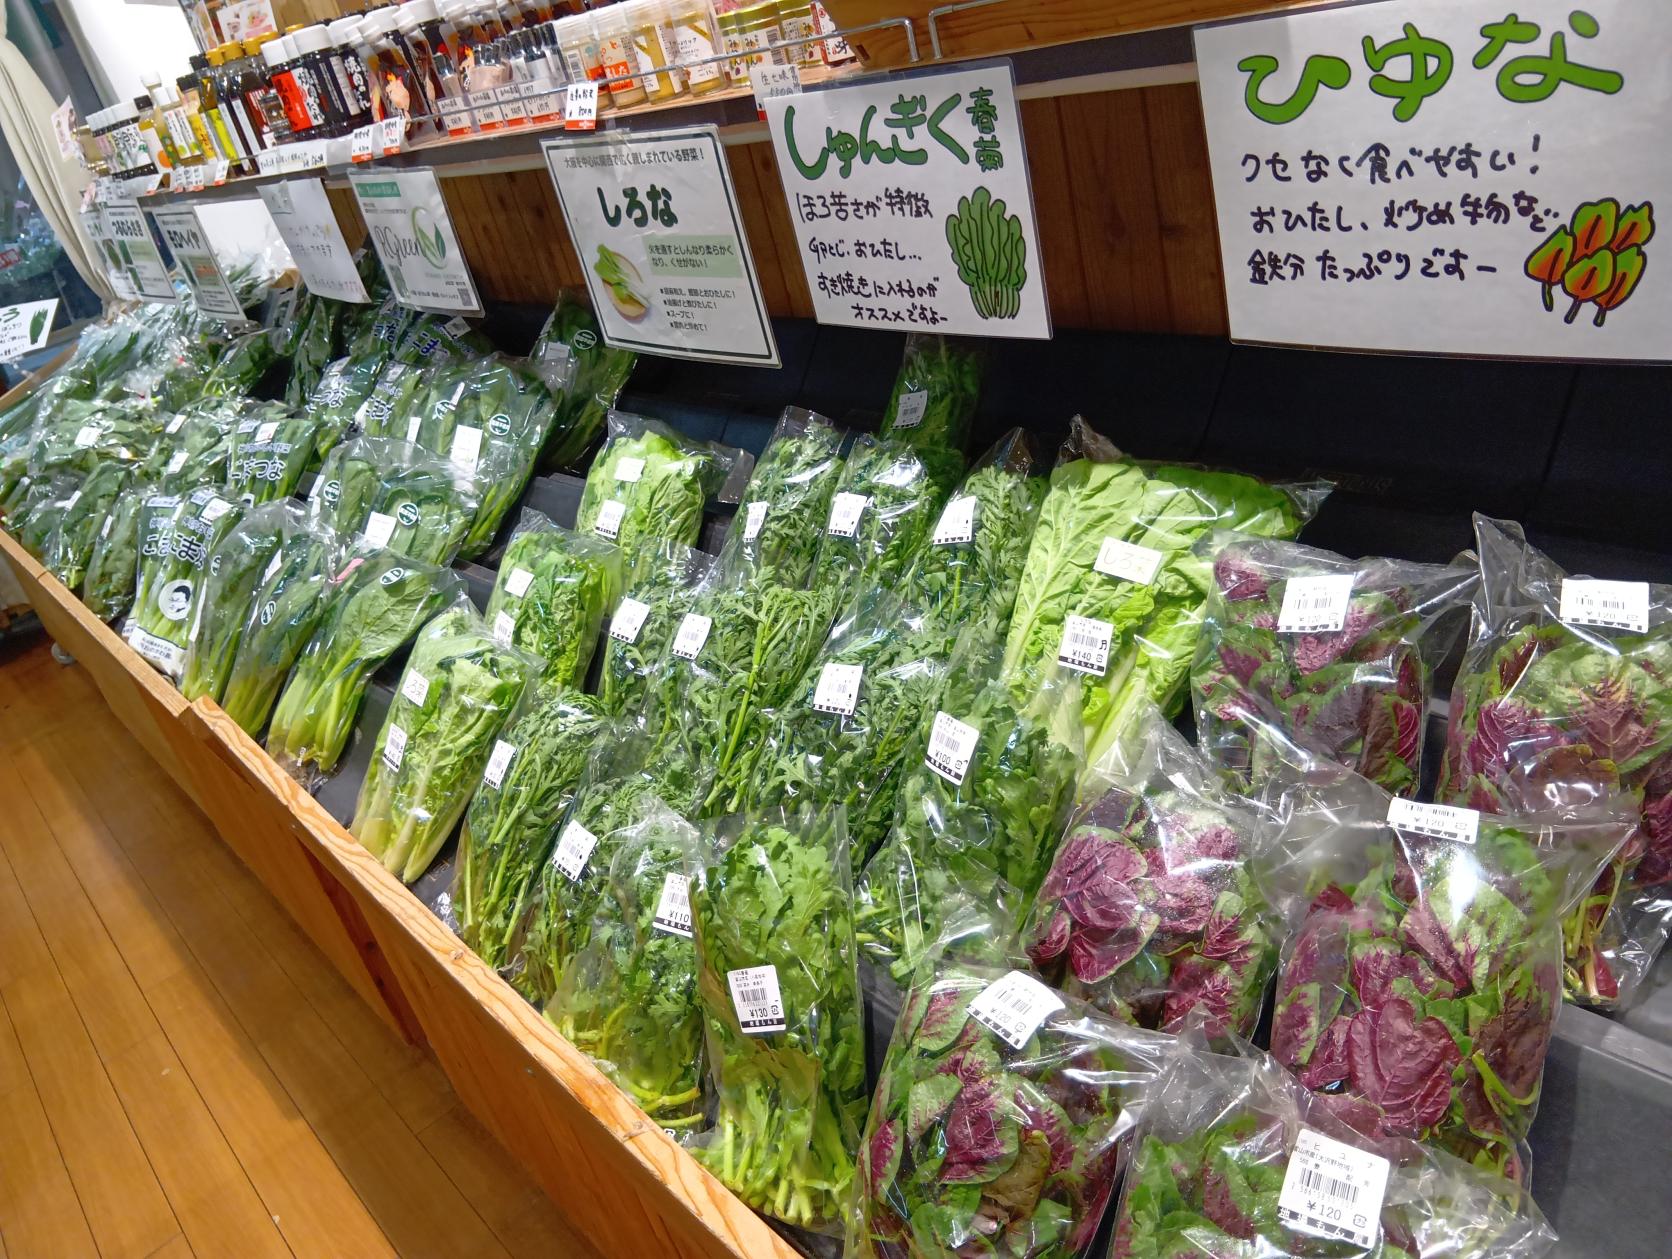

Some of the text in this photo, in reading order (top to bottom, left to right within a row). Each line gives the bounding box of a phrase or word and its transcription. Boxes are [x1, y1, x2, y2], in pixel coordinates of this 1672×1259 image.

[1238, 11, 1624, 125] ひゆな
[784, 93, 970, 180] しゅんぎく
[1241, 134, 1541, 185] クセなく食べやすい！
[597, 183, 679, 229] しろな
[796, 187, 933, 223] ほろ苦さが特徴
[648, 244, 735, 257] 火を通すとしんなり柔らかく
[651, 257, 709, 269] なり、くせがない！
[818, 270, 940, 299] すき焼きに入れるのが
[851, 303, 949, 326] オススメですよー
[669, 909, 690, 923] ¥110
[749, 1007, 769, 1019] ¥130
[1306, 1199, 1342, 1221] ¥120
